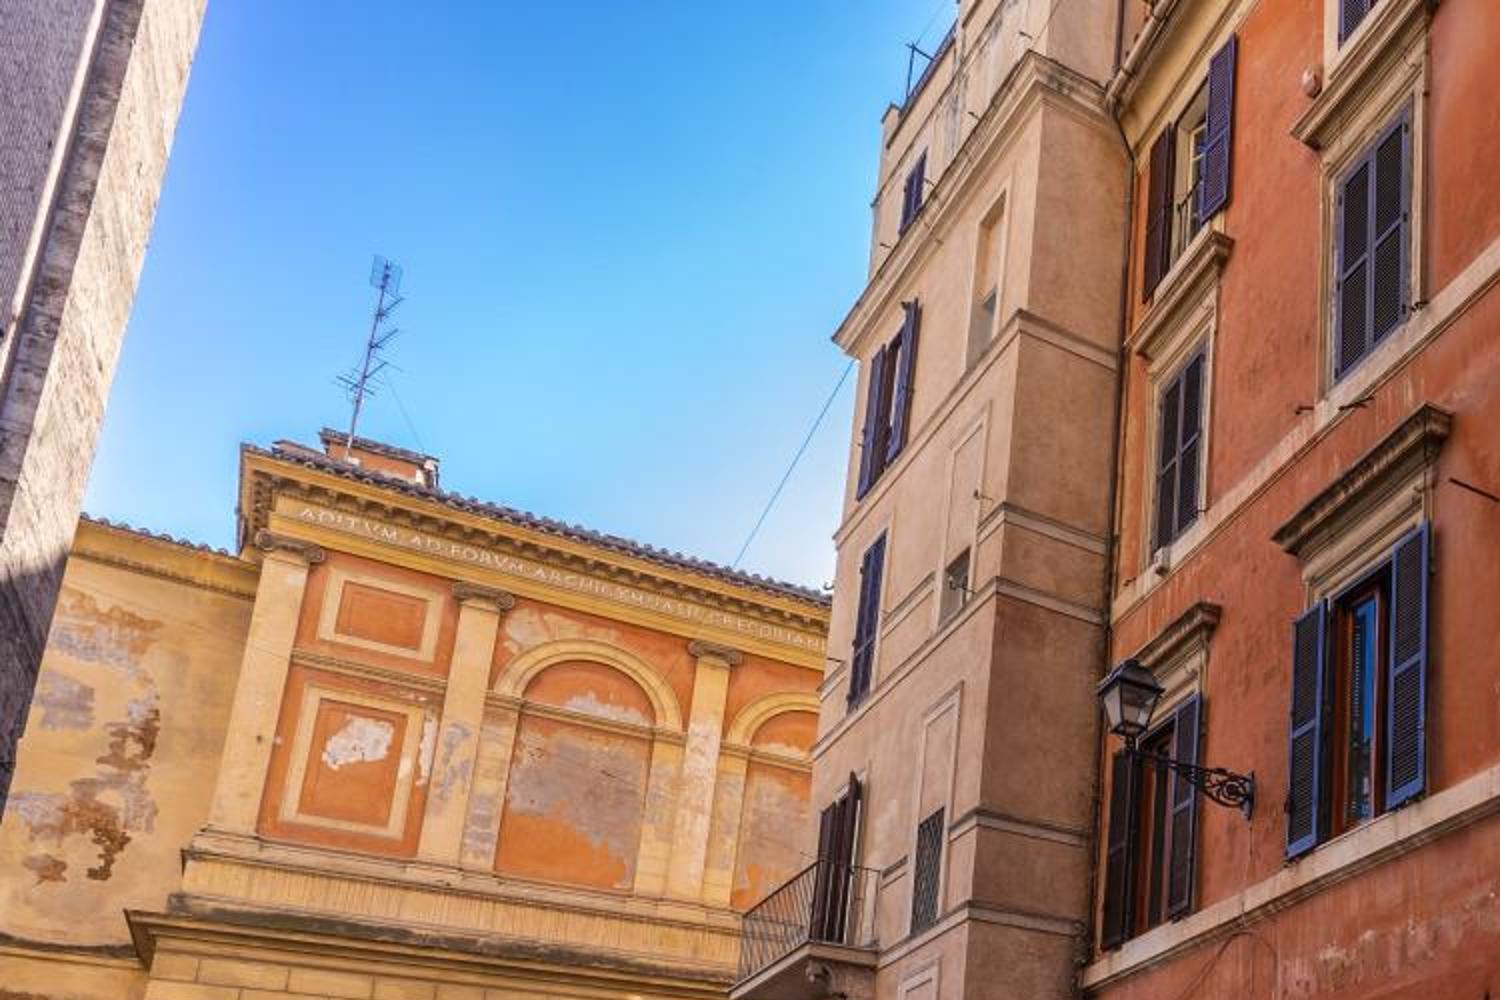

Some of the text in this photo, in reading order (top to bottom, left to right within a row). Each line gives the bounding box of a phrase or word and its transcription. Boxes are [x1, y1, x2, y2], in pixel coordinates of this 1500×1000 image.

[299, 507, 398, 541] ADITVM
[410, 535, 441, 551] AD
[450, 544, 524, 573] FORVM
